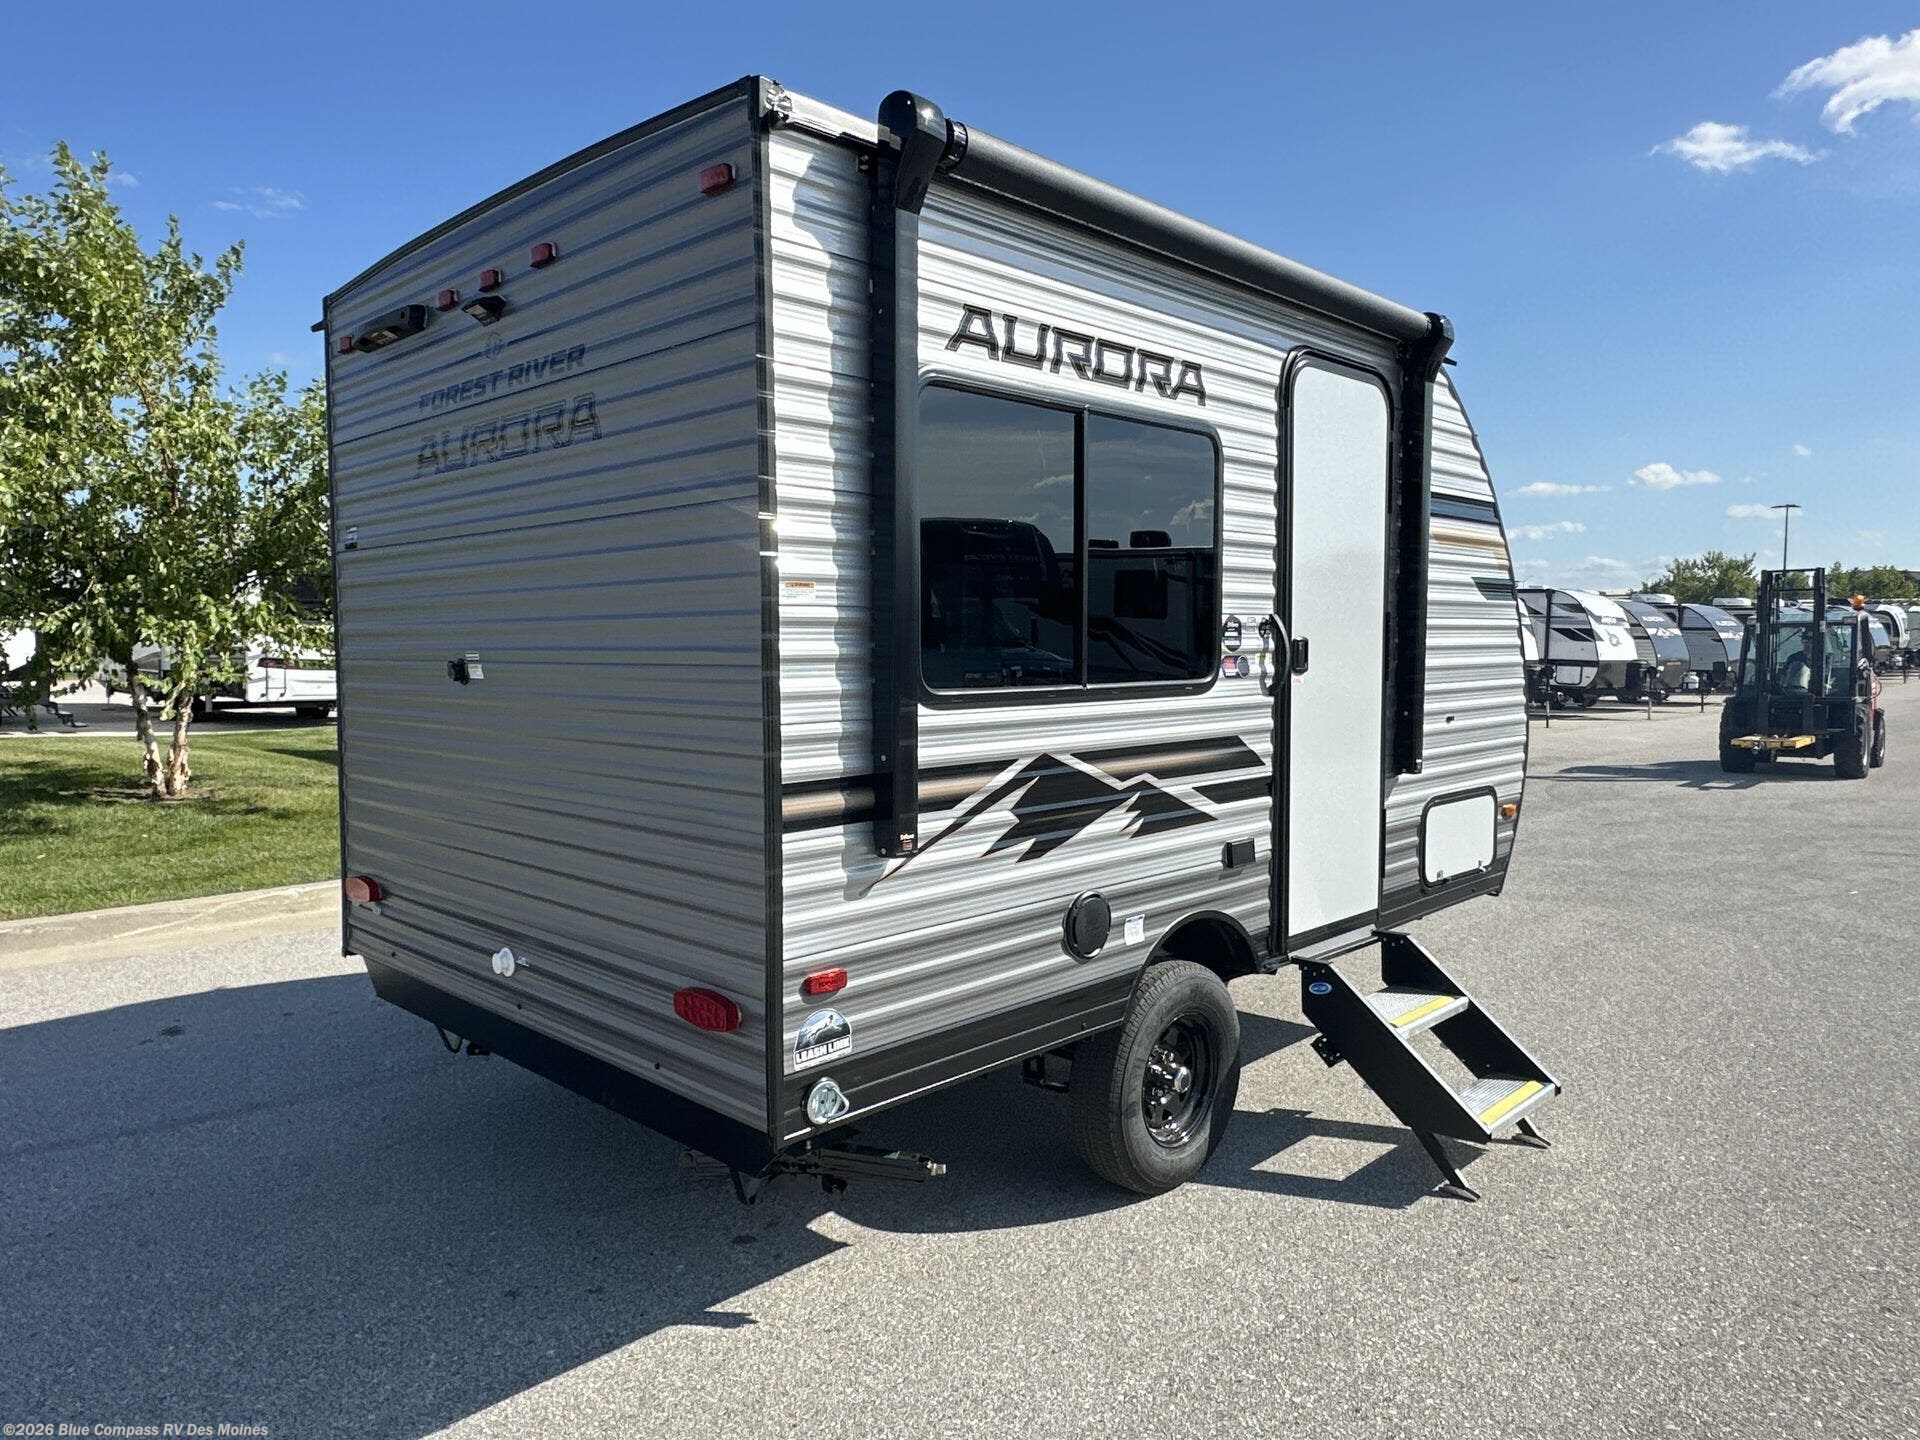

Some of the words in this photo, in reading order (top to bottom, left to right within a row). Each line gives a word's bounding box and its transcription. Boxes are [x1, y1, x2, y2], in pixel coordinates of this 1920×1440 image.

[418, 370, 504, 414] FOREST
[508, 344, 586, 388] RIVER
[944, 303, 1206, 406] AURORA
[416, 392, 602, 474] AURORA
